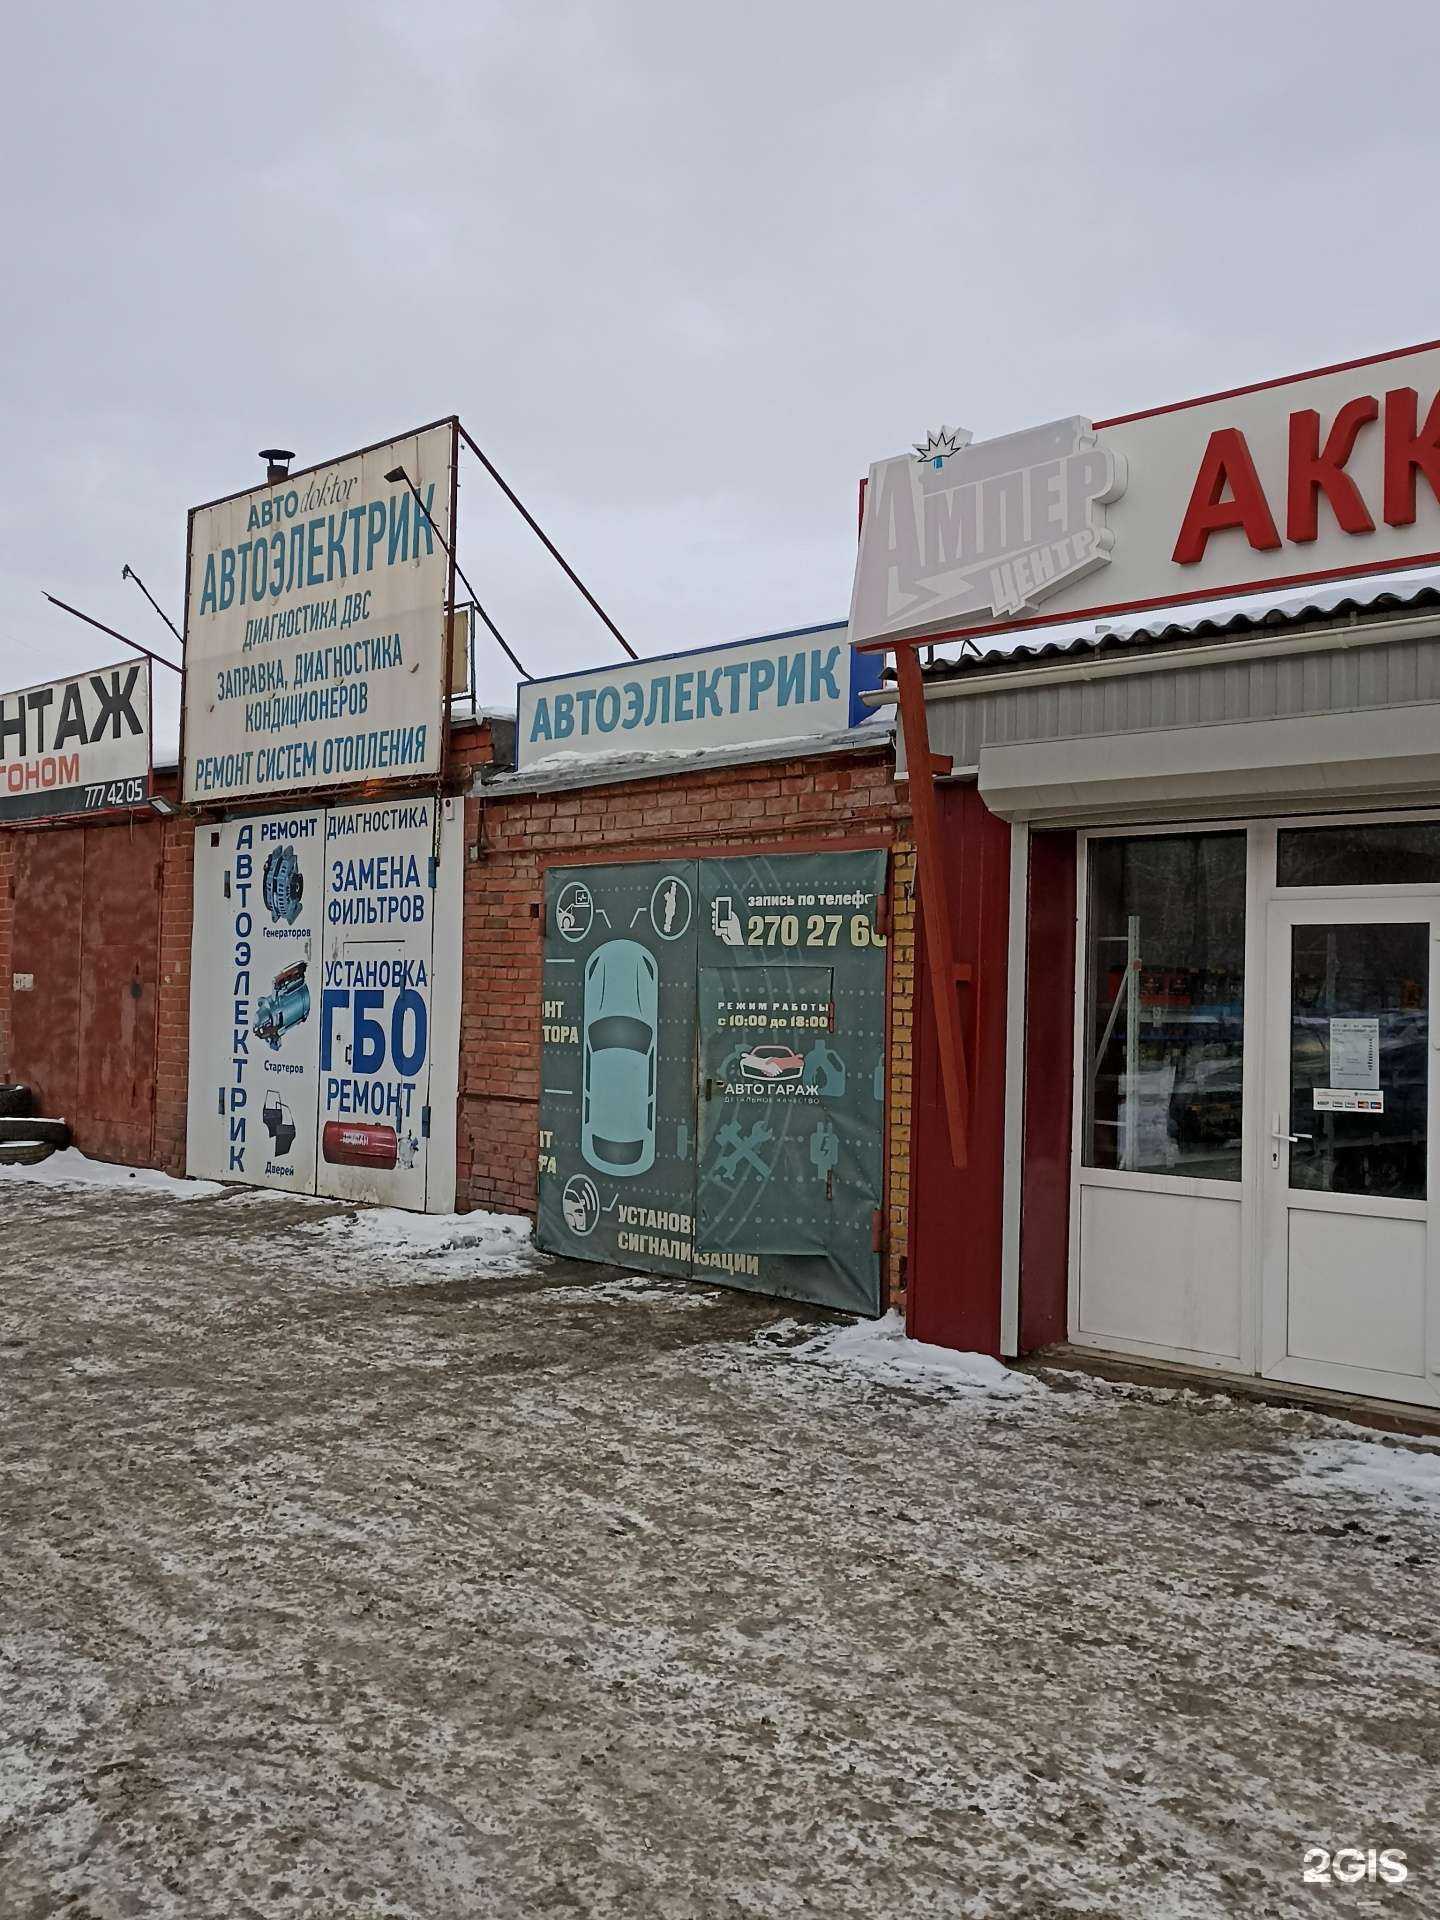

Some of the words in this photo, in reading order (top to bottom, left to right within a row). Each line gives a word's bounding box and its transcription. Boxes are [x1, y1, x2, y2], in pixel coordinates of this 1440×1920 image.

[247, 490, 299, 532] АВТО
[300, 473, 358, 513] doktor
[866, 448, 1108, 615] АМПЕР
[200, 483, 436, 616] АВТОЭЛЕКТРИК
[990, 529, 1094, 616] ЦЕНТР
[243, 598, 337, 653] ДИАГНОСТИКА
[340, 590, 372, 630] ДВС
[217, 659, 288, 700] ЗАПРАВКА,
[294, 633, 403, 690] ДИАГНОСТИКА
[245, 681, 369, 734] КОНДИЦИОНЕРОВ
[529, 646, 841, 743] АВТОЭЛЕКТРИК
[195, 751, 253, 791] РЕМОНТ
[256, 740, 317, 783] СИСТЕМ
[323, 725, 427, 775] ОТОПЛЕНИЯ
[85, 785, 106, 808] 777
[107, 782, 124, 805] 42
[126, 779, 143, 802] 05
[261, 818, 317, 841] РЕМОНТ
[327, 807, 428, 841] ДИАГНОСТИКА
[331, 854, 421, 893] ЗАМЕНА
[328, 894, 425, 925] ФИЛЬТРОВ
[748, 894, 795, 907] запись
[798, 894, 815, 906] по
[263, 927, 311, 940] Генераторов
[748, 915, 799, 946] 270
[806, 914, 843, 946] 27
[325, 960, 428, 988] УСТАНОВКА
[229, 824, 253, 1173] АВТОЭЛЕКТРИК
[541, 1000, 564, 1018] НТ
[718, 1002, 767, 1011] РЕЖИМ
[772, 1002, 828, 1012] РАБОТЫ
[321, 988, 428, 1077] ГБО
[718, 1017, 726, 1026] с
[729, 1014, 767, 1027] 10:00
[770, 1018, 787, 1029] до
[790, 1015, 828, 1028] 18:00
[264, 1060, 304, 1074] Стартеров
[327, 1078, 416, 1118] РЕМОНТ
[725, 1083, 764, 1095] АВТО
[767, 1084, 819, 1096] ГАРАЖ
[265, 1161, 294, 1176] Дверей
[618, 1204, 696, 1236] УСТАНОВ
